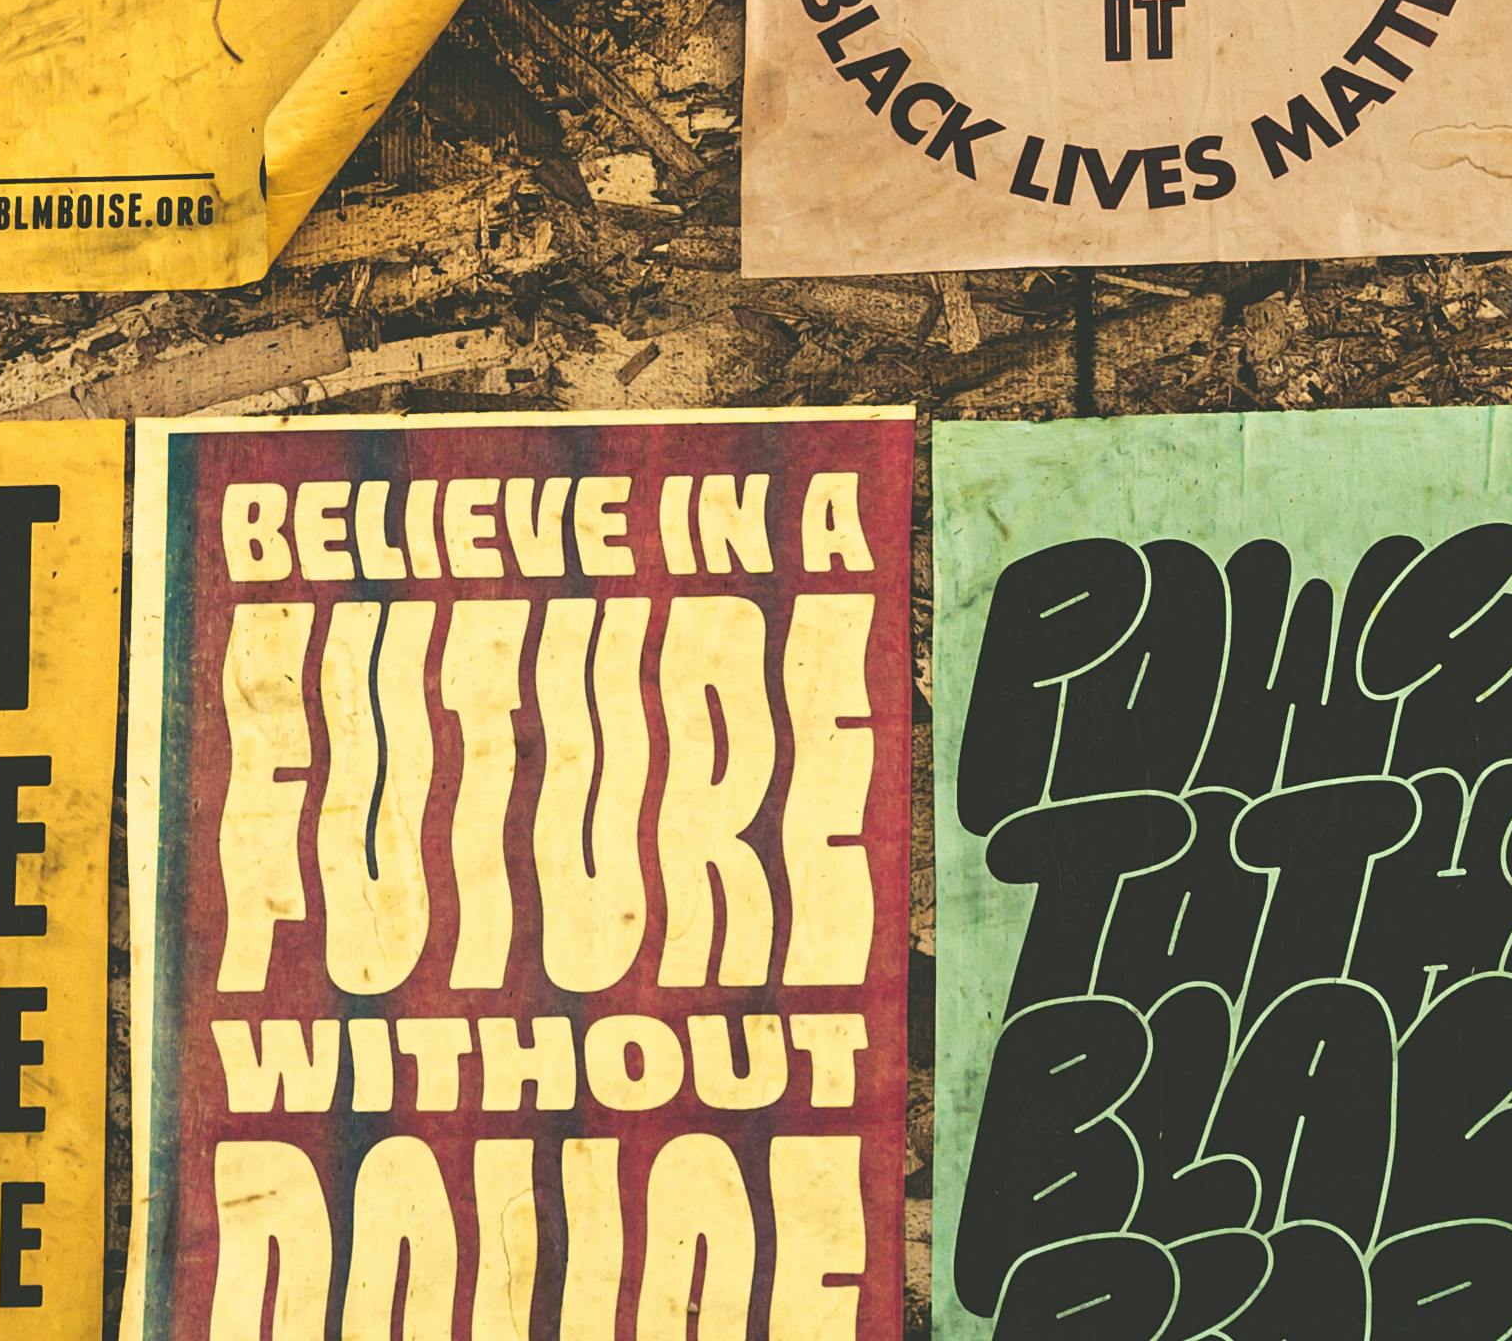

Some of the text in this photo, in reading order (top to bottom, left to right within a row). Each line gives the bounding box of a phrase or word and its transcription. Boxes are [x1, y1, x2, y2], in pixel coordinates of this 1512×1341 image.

[1010, 136, 1236, 209] LIVES
[222, 473, 874, 581] BELIEVE IN A
[217, 594, 875, 994] FUTURE
[211, 1014, 868, 1112] WITHOUT
